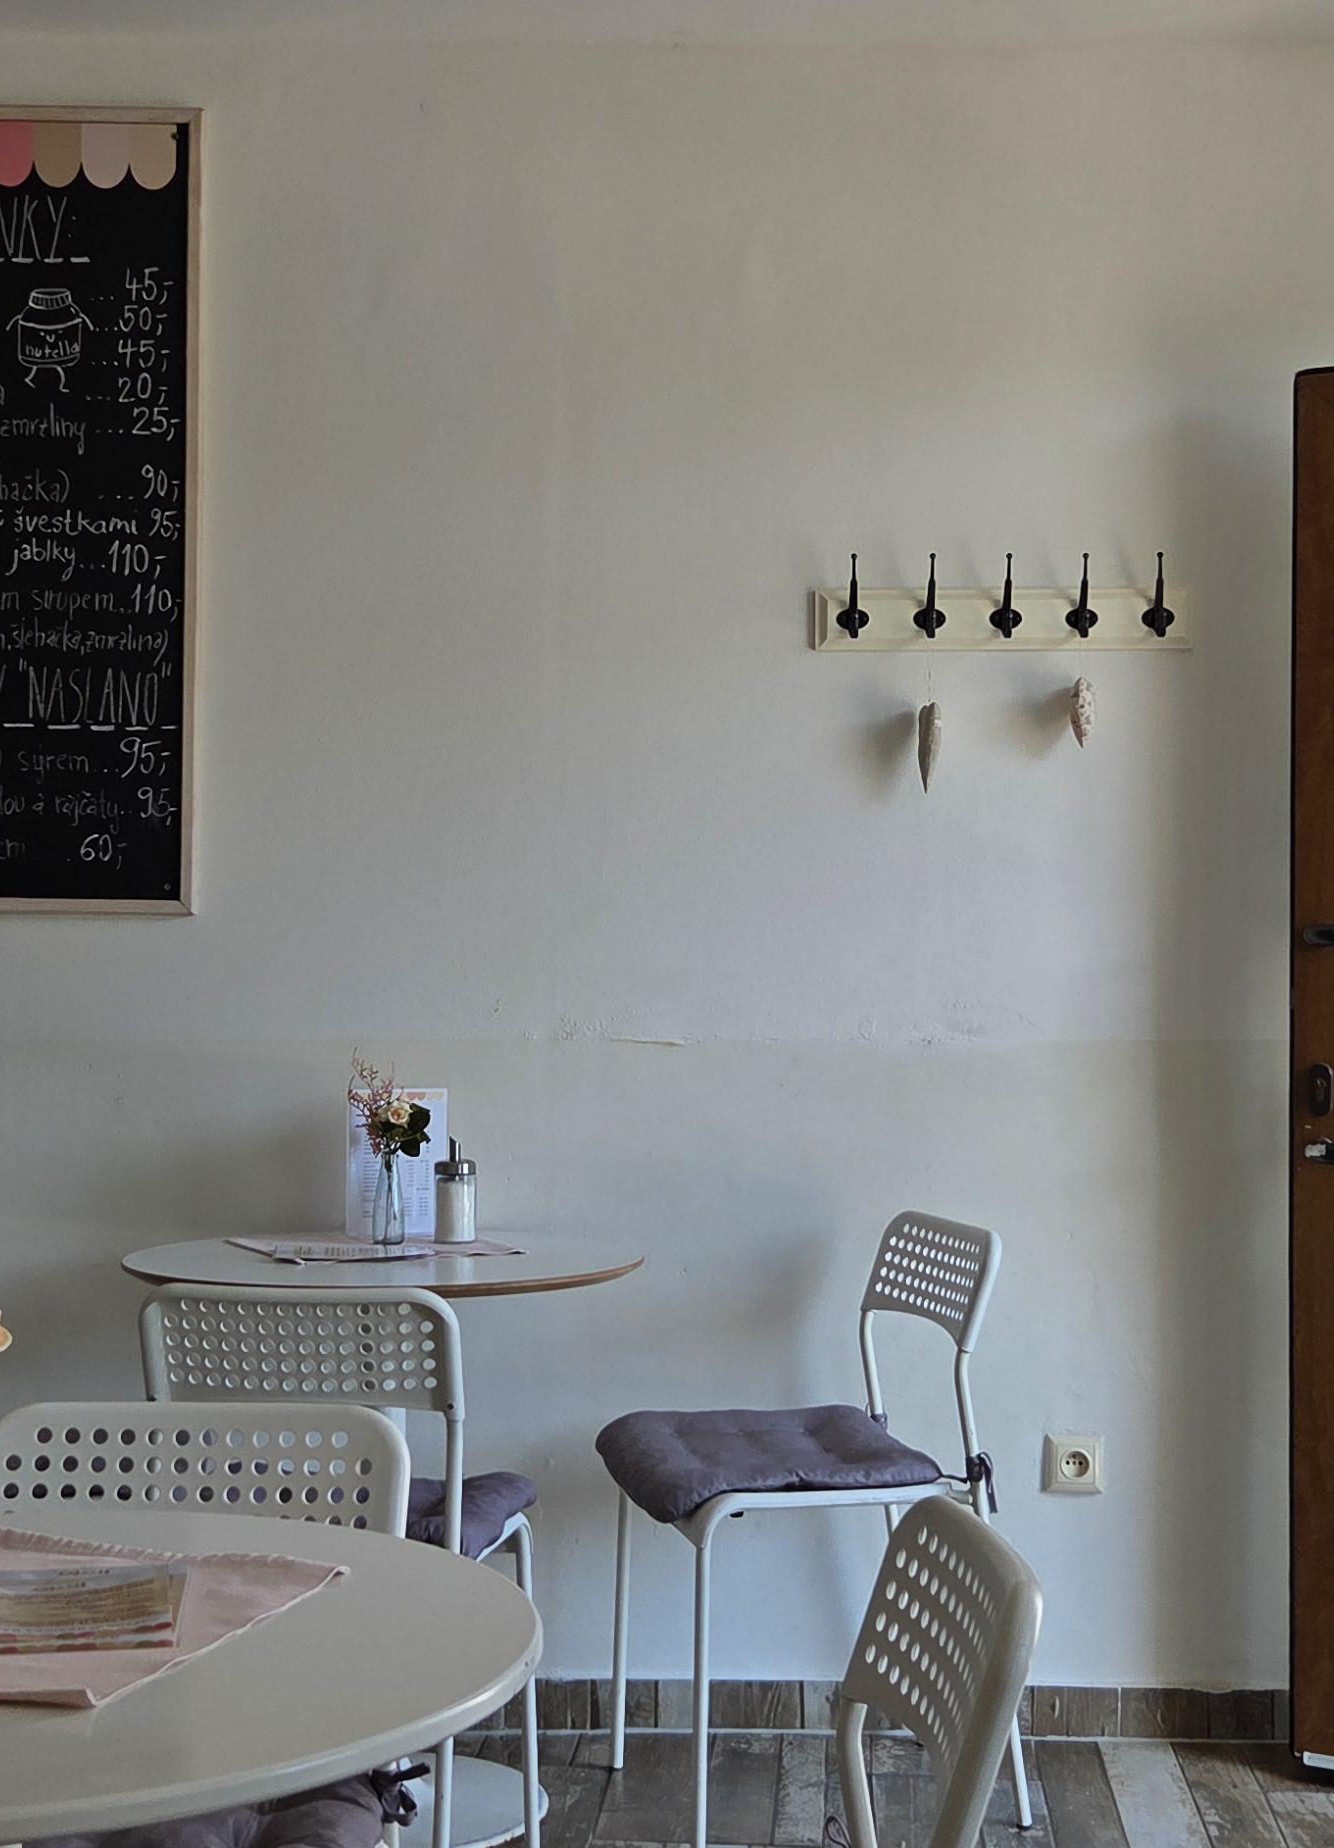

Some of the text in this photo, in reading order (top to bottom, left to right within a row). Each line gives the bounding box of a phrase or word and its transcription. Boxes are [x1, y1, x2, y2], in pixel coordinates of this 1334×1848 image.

[125, 267, 175, 305] 45,-
[119, 305, 170, 337] 50,-
[25, 340, 80, 359] nutella
[117, 339, 171, 373] 45,-
[117, 372, 169, 405] 20,-
[0, 402, 86, 455] zmrzliny
[132, 407, 181, 441] 25,-
[141, 464, 180, 502] 90,-
[13, 505, 139, 536] švestkami
[5, 537, 75, 582] jablky
[108, 540, 167, 579] 110,-
[31, 588, 114, 620] sirupem
[131, 583, 182, 623] 110,-
[18, 745, 89, 784] sýrem
[120, 736, 171, 779] 95,-
[80, 833, 128, 870] 60,-
